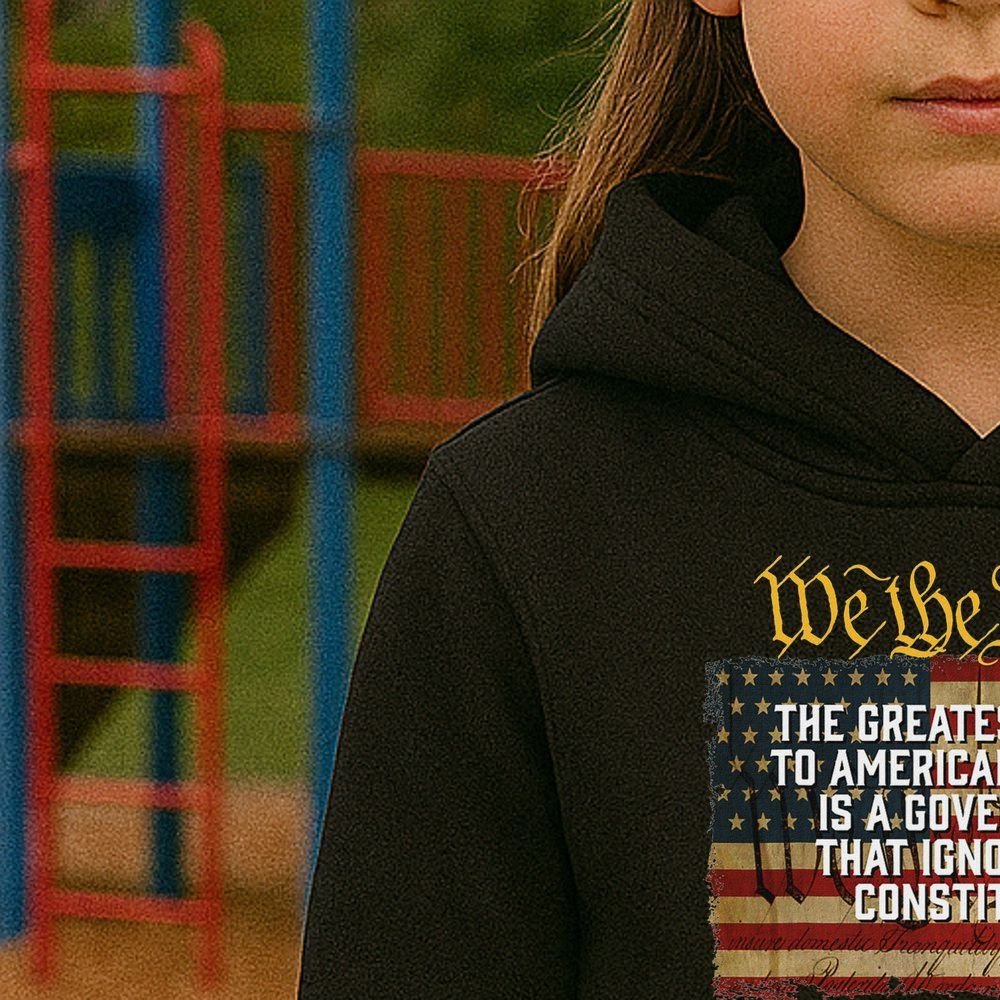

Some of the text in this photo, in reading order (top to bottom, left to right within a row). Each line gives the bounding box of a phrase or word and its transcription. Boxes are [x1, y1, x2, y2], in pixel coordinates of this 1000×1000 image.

[754, 554, 887, 661] We
[884, 560, 999, 661] the
[774, 704, 845, 743] THE
[770, 749, 817, 787] TO
[819, 793, 853, 832] IS
[866, 793, 892, 832] A
[815, 838, 910, 877] THAT
